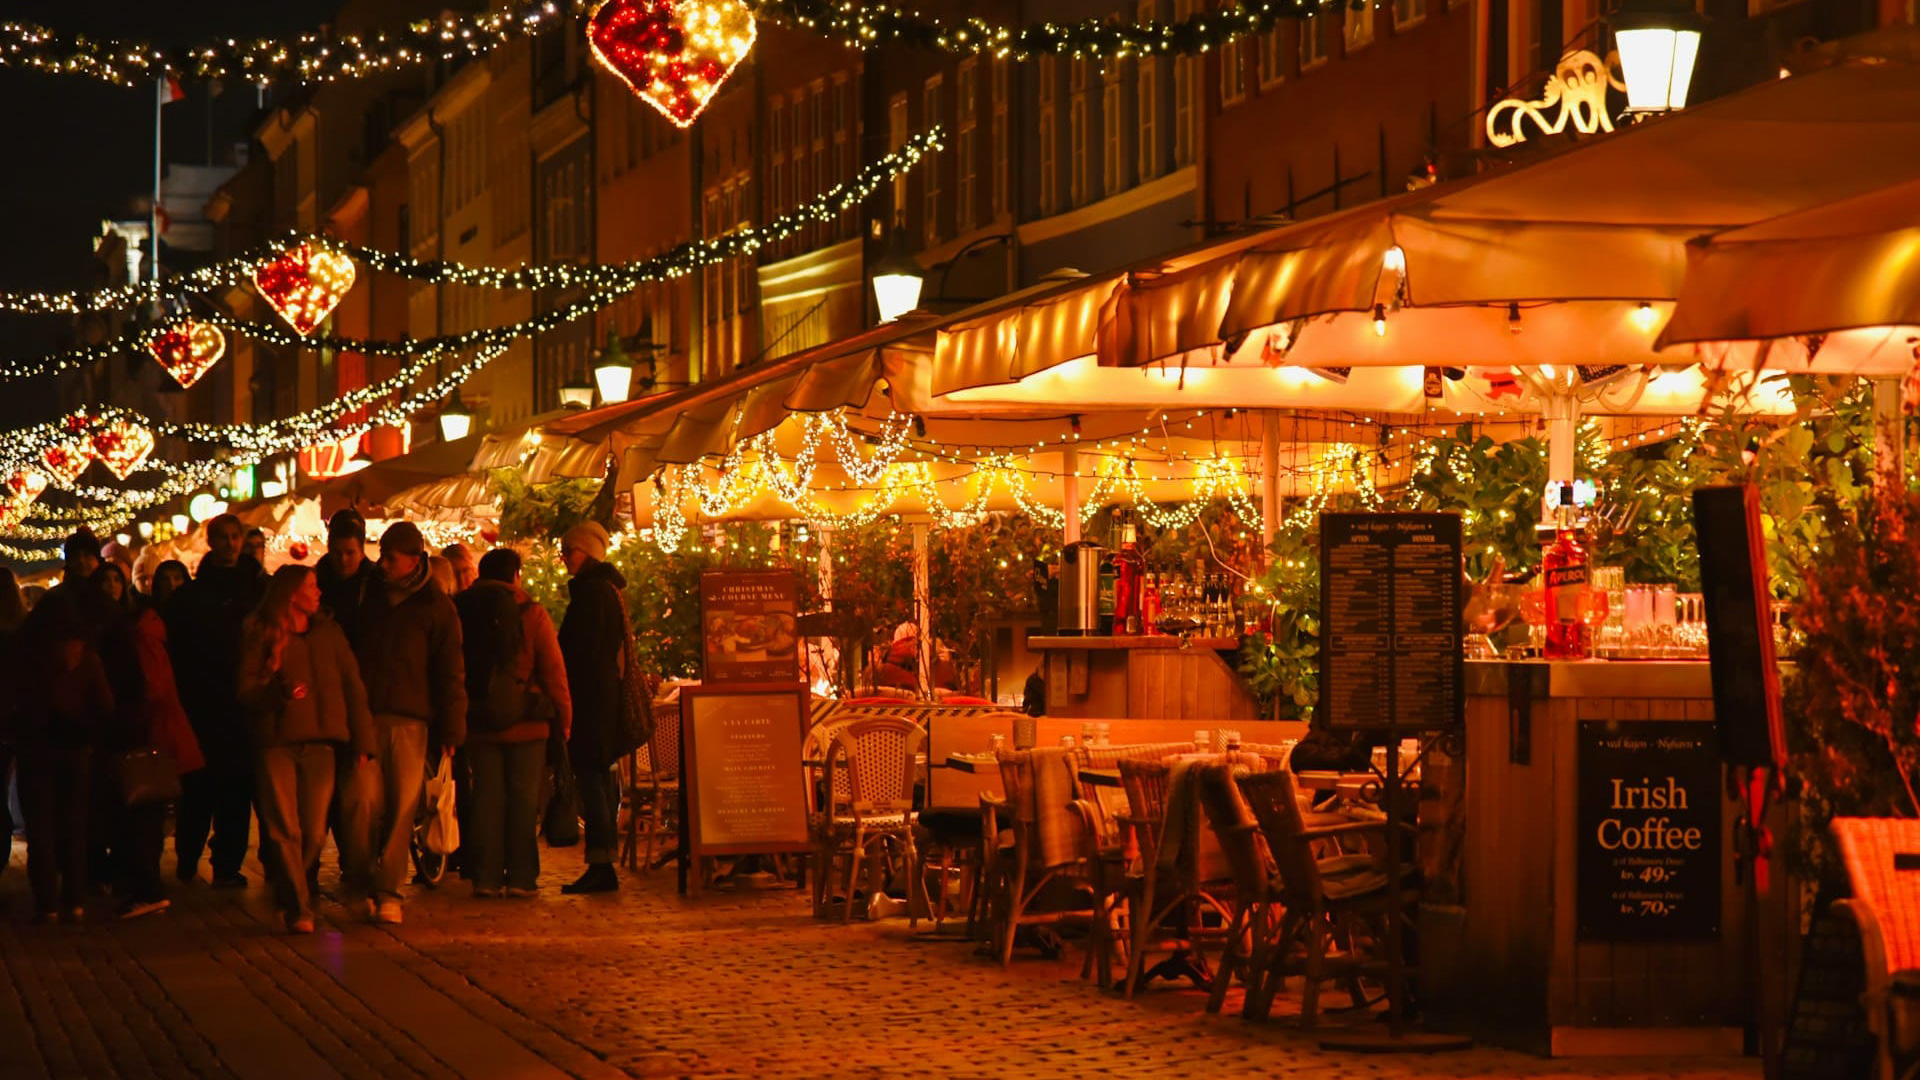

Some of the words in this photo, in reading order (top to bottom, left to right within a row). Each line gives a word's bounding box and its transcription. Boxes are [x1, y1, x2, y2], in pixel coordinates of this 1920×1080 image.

[302, 442, 339, 477] 17
[1549, 568, 1585, 585] APEROL
[722, 584, 775, 593] CHRISTMAS
[1610, 776, 1688, 810] Irish
[1597, 817, 1702, 850] Coffee
[1620, 868, 1635, 880] kr.
[1639, 866, 1678, 883] 49,-
[1620, 903, 1635, 914] kr.
[1639, 900, 1677, 917] 70,-
